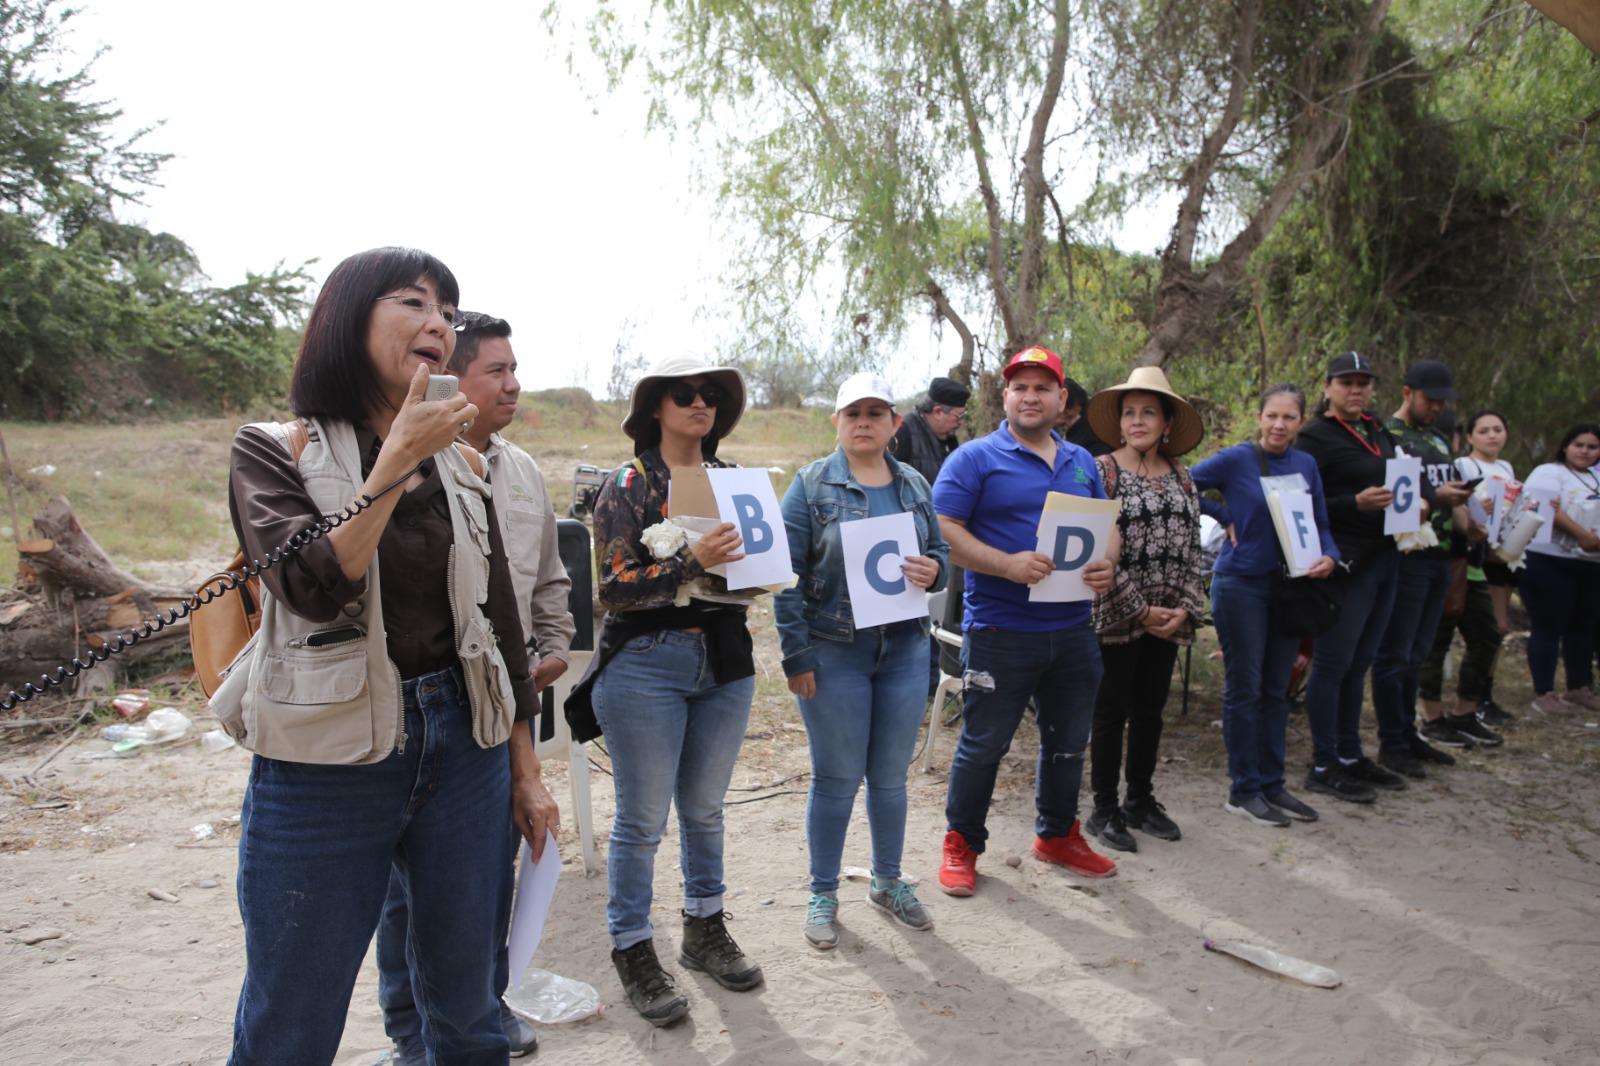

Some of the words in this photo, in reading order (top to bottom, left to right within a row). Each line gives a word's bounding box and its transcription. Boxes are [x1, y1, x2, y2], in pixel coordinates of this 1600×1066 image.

[1392, 475, 1413, 514] G
[732, 494, 774, 555] B
[1292, 510, 1308, 549] F
[864, 539, 906, 596] C
[1053, 526, 1096, 572] D
